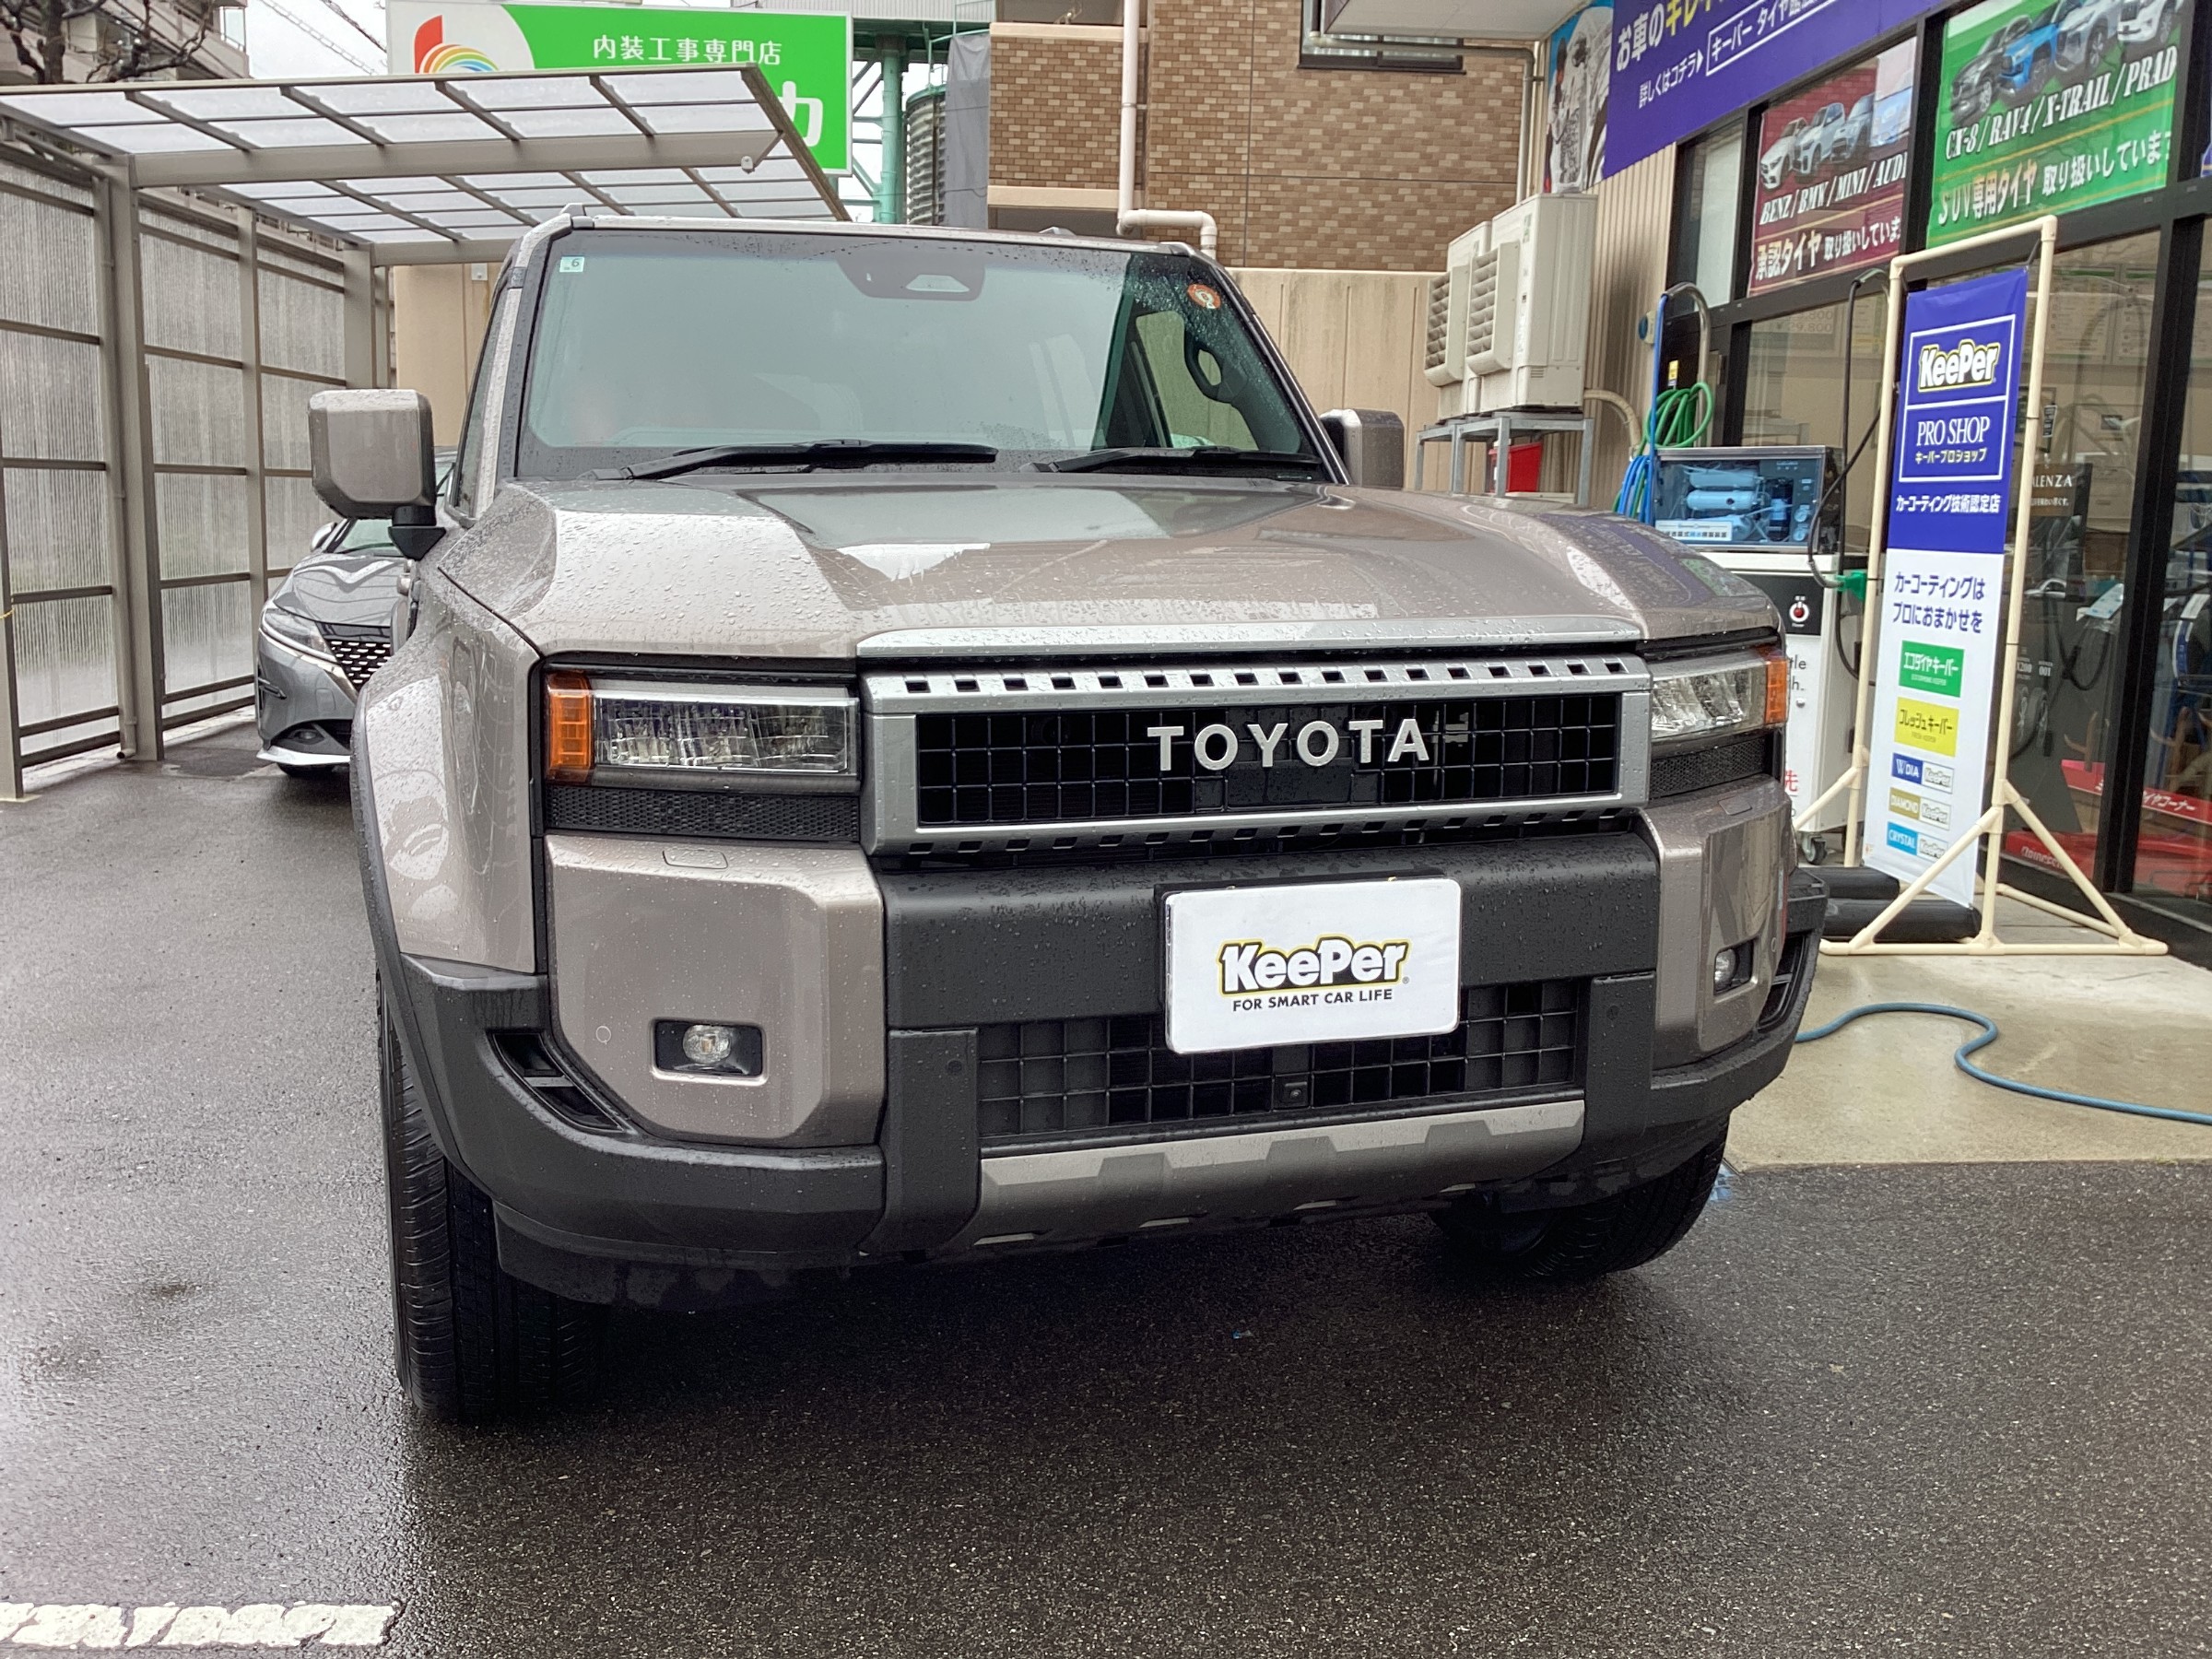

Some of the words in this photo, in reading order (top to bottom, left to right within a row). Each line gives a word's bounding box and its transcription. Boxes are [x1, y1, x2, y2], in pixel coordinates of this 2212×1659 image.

[593, 34, 782, 65] 内装工事専門店
[1617, 0, 1712, 72] お車のキレ
[1639, 52, 1697, 109] 詳しくはコチラ
[1946, 124, 1981, 159] CX-8
[1988, 103, 2033, 146] RAV4
[2042, 73, 2112, 128] X-TRAIL
[1759, 194, 1793, 226] BENZ
[1824, 216, 1901, 261] 取り扱いしていま
[1918, 340, 2000, 392] KeePer
[1916, 419, 1946, 447] PRO
[1947, 416, 1991, 444] SHOP
[1915, 447, 1987, 465] キーパープロショップ
[1896, 493, 2001, 513] カーコーティング技術認定店
[1894, 571, 1985, 600] カーコーティングは
[1893, 601, 1983, 634] プロにおまかせを
[1147, 718, 1430, 771] TOYOTA
[1889, 830, 1916, 849] CRYSTAL
[1217, 933, 1412, 996] KeePer
[1232, 998, 1263, 1012] FOR
[1268, 994, 1319, 1009] SMART
[1324, 992, 1354, 1005] CAR
[1359, 989, 1394, 1002] LIFE
